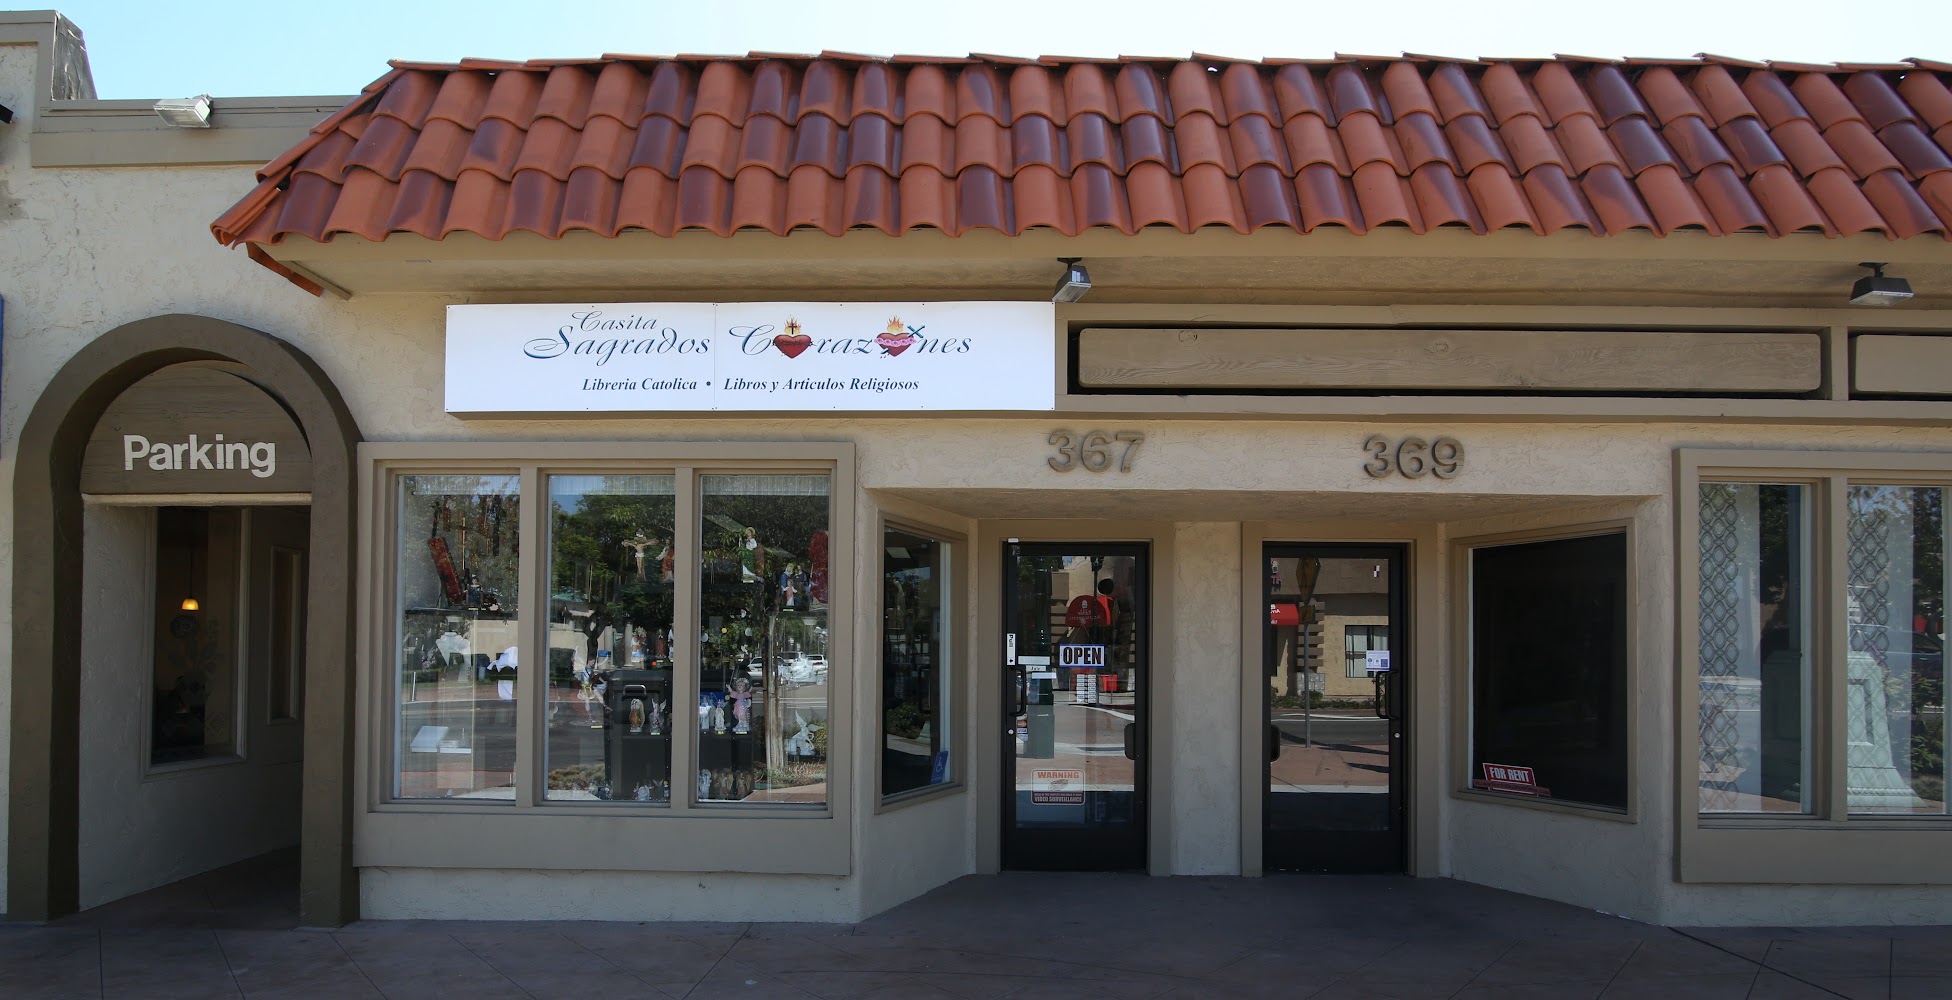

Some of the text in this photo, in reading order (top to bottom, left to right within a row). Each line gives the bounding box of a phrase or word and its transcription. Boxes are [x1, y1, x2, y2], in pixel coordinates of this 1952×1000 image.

[572, 310, 658, 332] Casita
[523, 321, 972, 367] Sagrados Craznes
[582, 378, 920, 393] Libreria Catolica Libros y Articulos Religiosos
[123, 434, 276, 478] Parking
[1048, 430, 1146, 473] 367
[1363, 435, 1465, 480] 369
[1063, 646, 1102, 665] OPEN
[1037, 771, 1080, 779] WARNING
[1489, 767, 1530, 782] FOR RENT
